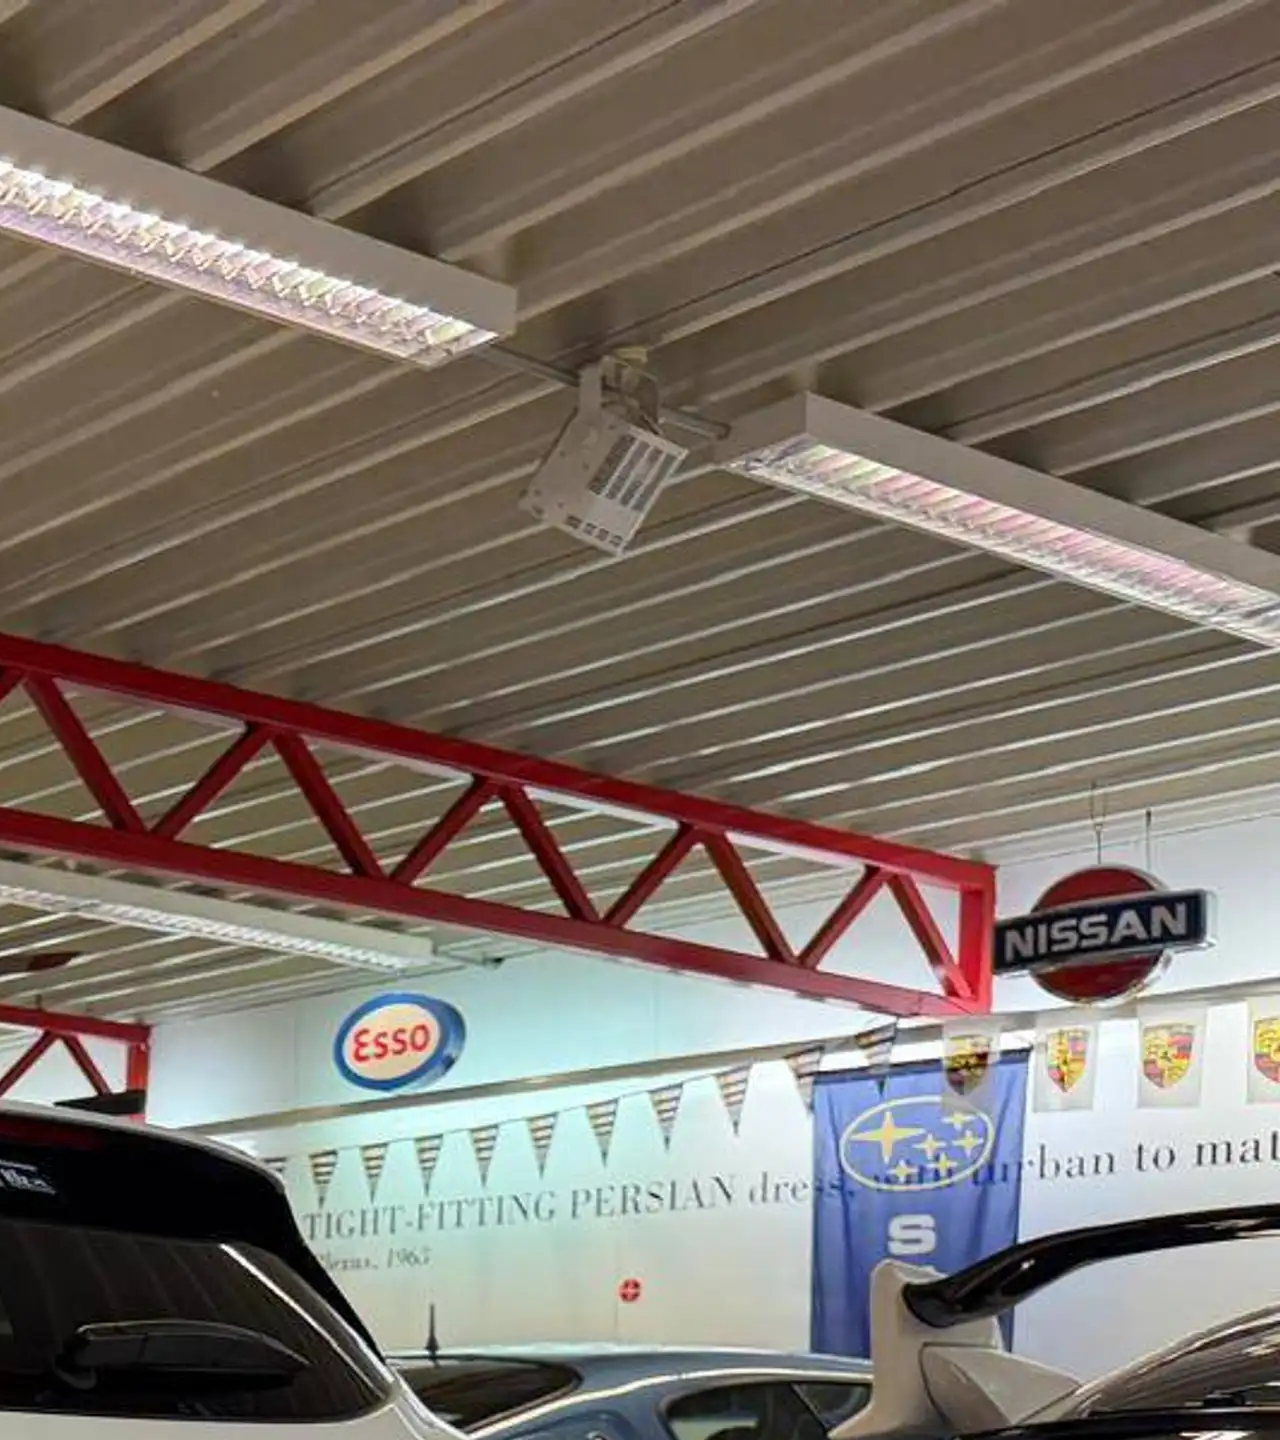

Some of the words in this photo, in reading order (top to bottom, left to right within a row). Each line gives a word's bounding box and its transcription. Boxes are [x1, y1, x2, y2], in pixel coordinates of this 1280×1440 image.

[1004, 901, 1188, 963] NISSAN
[570, 1173, 737, 1220] PERSIAN
[1137, 1141, 1177, 1172] to
